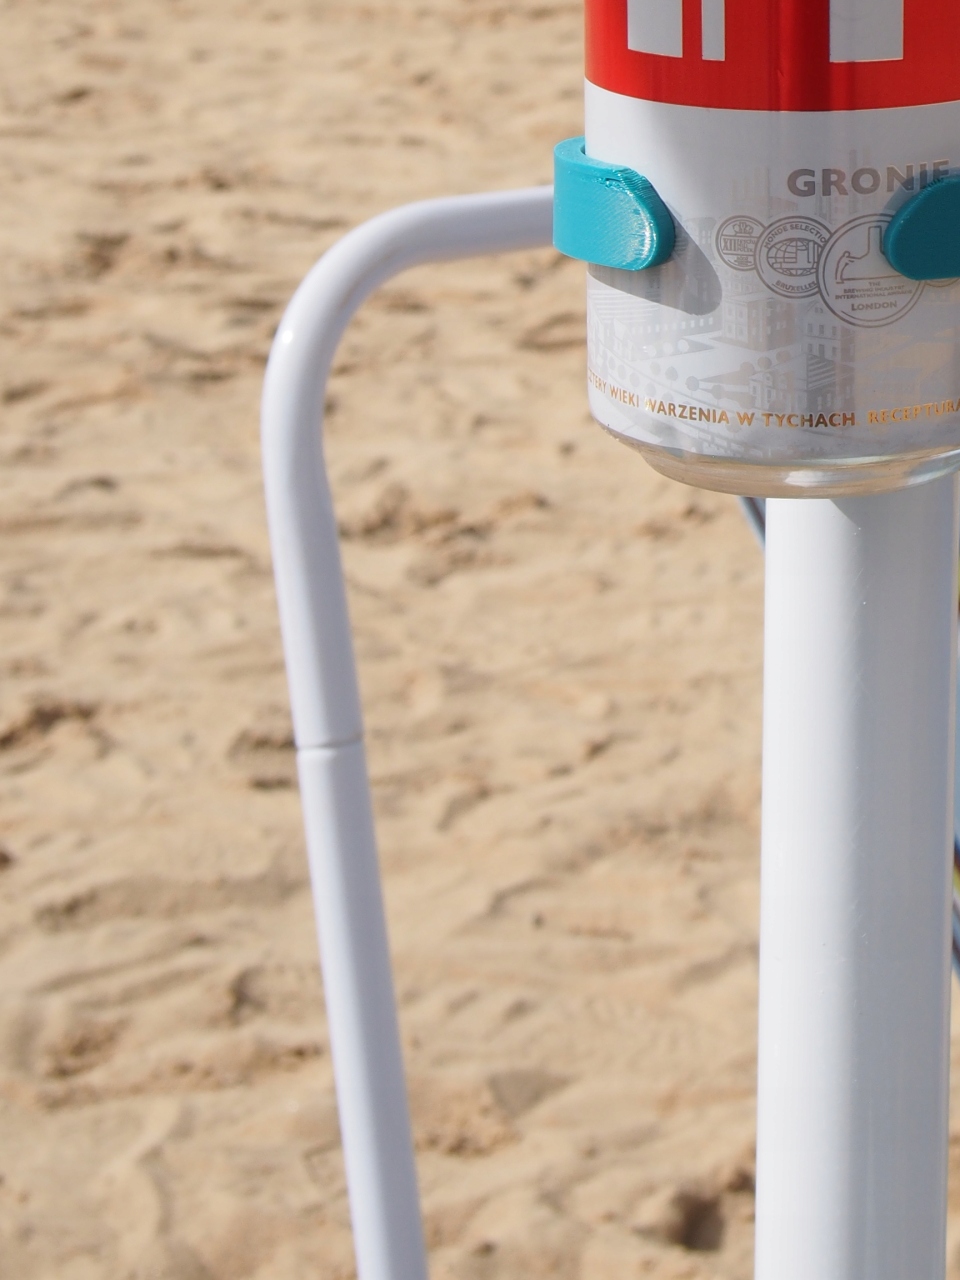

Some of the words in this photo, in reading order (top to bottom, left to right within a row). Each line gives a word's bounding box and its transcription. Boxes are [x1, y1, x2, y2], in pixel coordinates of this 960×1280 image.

[764, 225, 789, 249] MONDE
[851, 300, 898, 311] LONDON
[609, 383, 639, 408] WIEKI
[645, 397, 730, 425] WARZENIA
[736, 411, 756, 427] W
